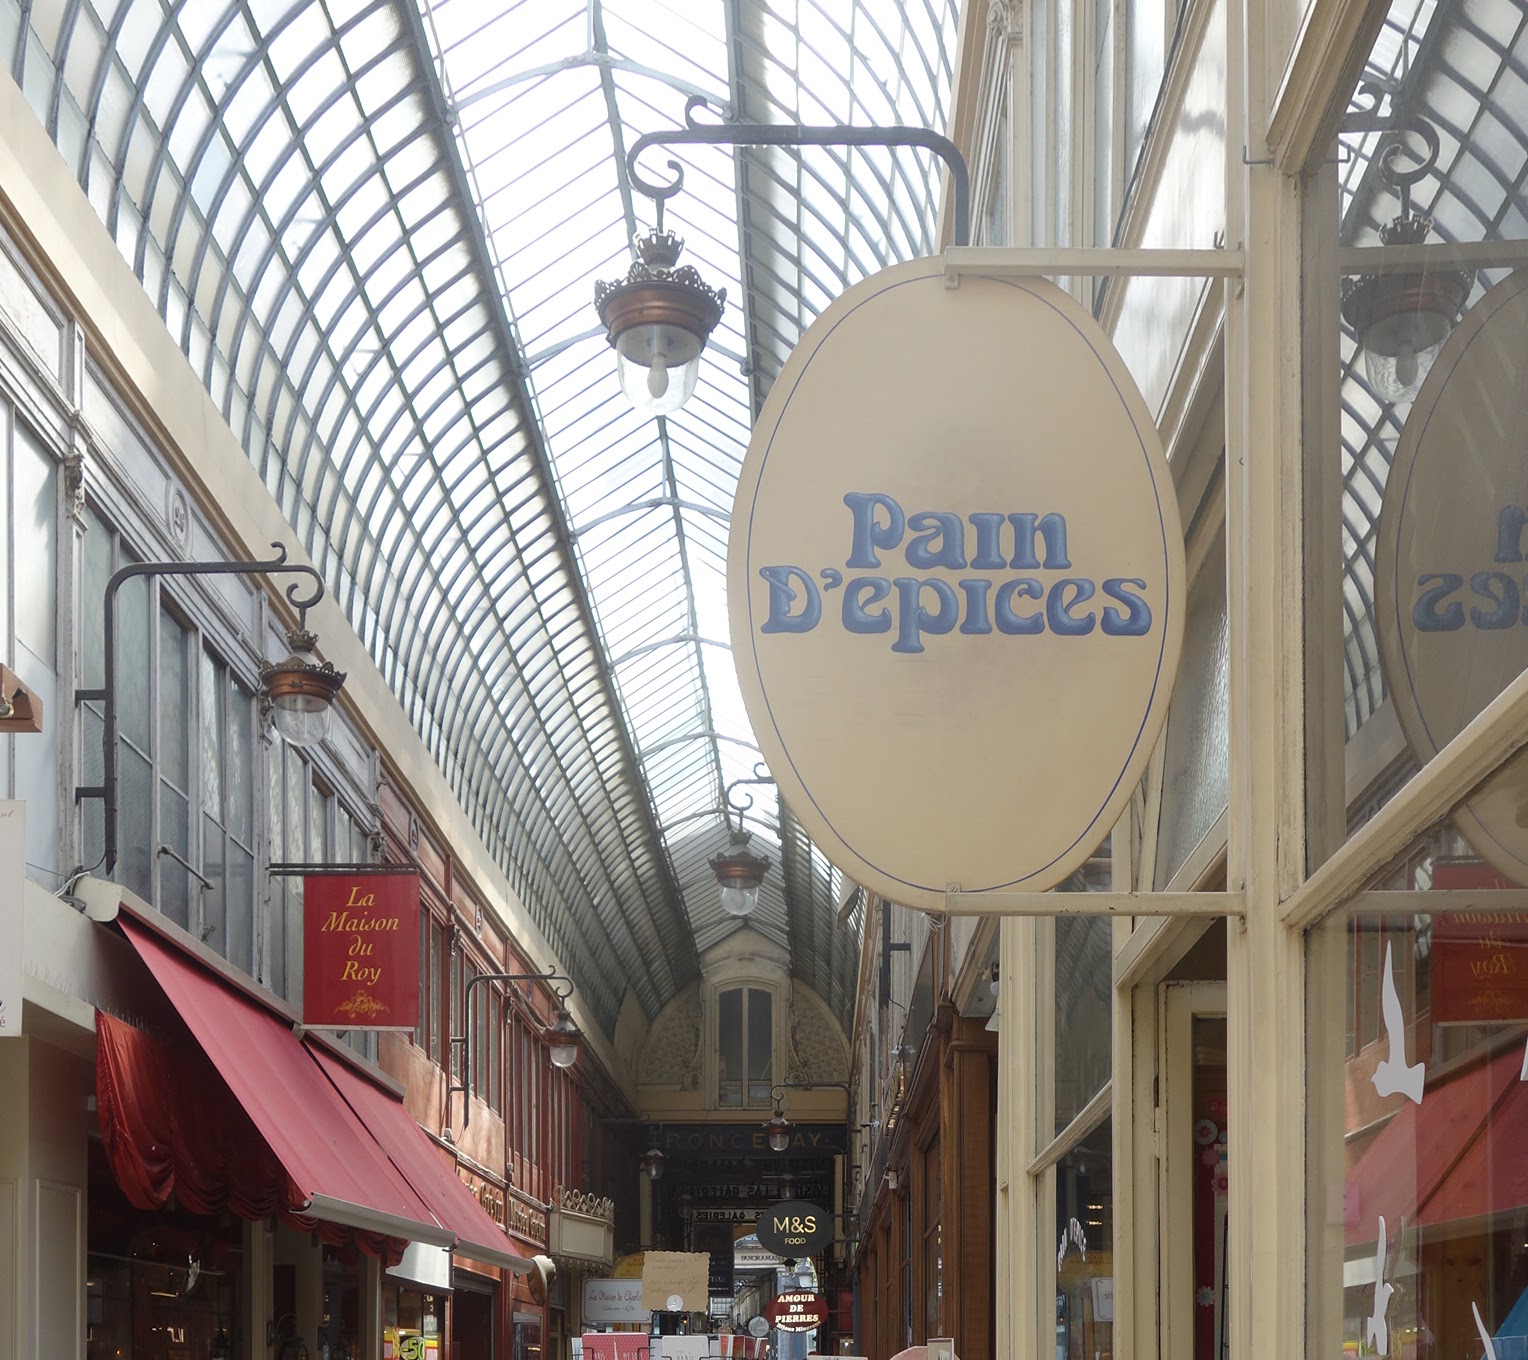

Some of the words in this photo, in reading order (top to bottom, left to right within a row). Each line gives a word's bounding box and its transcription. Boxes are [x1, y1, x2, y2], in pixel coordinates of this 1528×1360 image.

[842, 491, 1073, 572] Pain
[346, 886, 375, 907] La
[321, 911, 400, 932] Maison
[348, 935, 373, 956] du
[340, 960, 382, 986] Roy
[666, 1131, 824, 1149] RONCEAY
[773, 1216, 817, 1234] M&S
[784, 1237, 806, 1245] FOOD
[777, 1294, 815, 1303] AMOUR
[789, 1304, 804, 1313] DE
[775, 1314, 819, 1323] PIERRES
